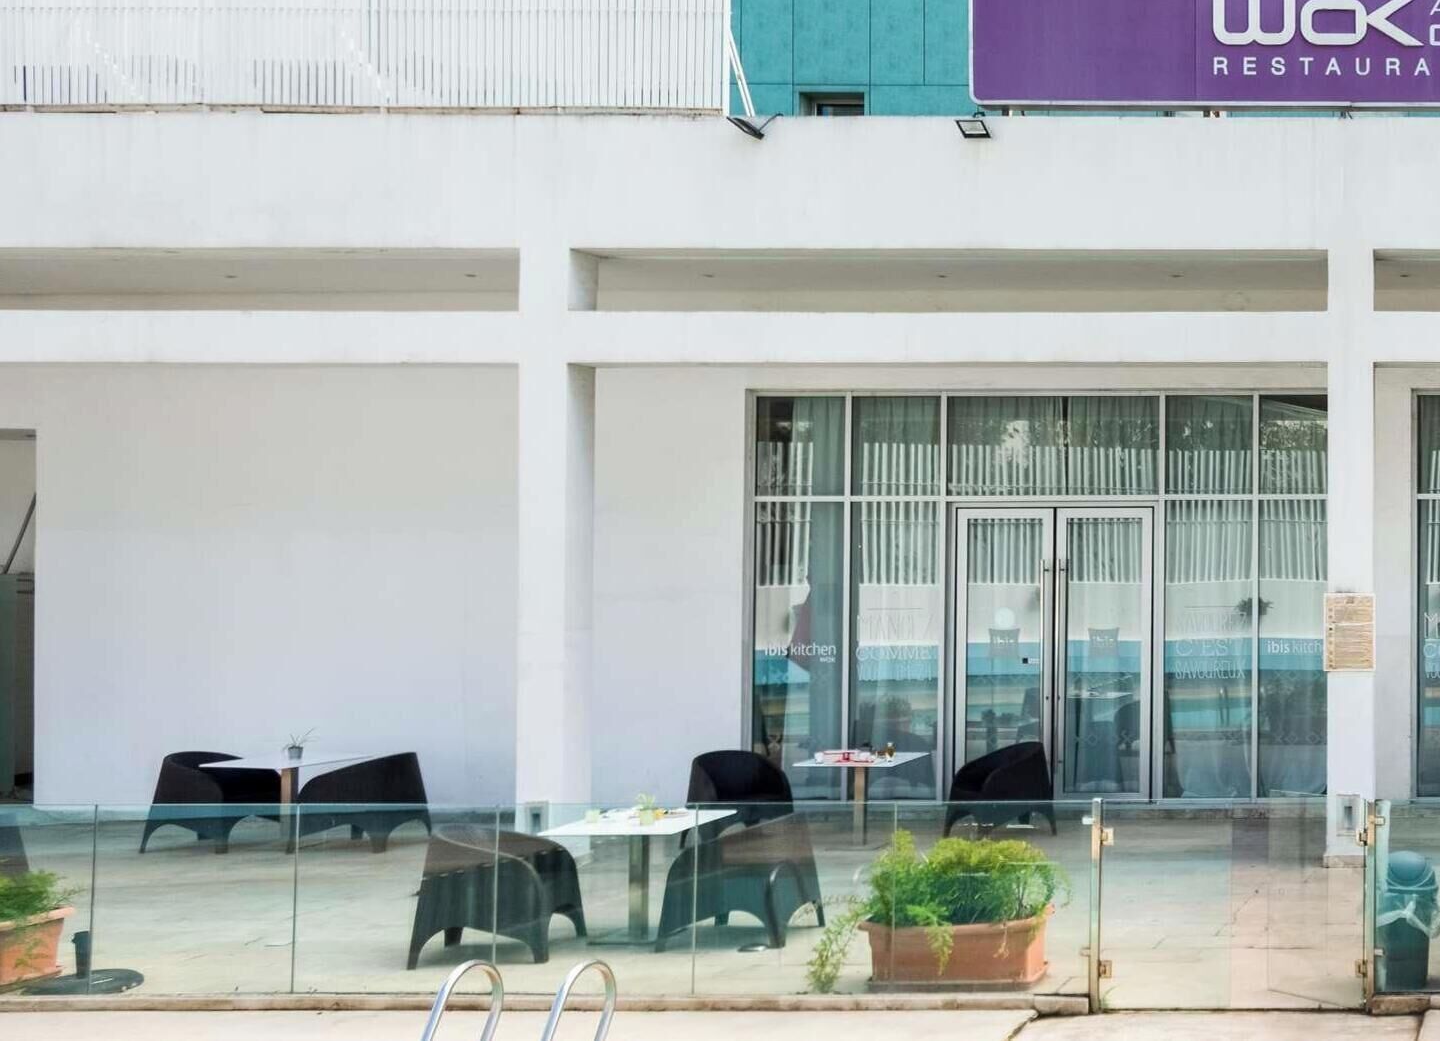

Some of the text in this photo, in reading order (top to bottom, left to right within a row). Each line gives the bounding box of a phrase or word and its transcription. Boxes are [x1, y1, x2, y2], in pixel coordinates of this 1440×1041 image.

[764, 642, 837, 656] ibis kitchen
[1267, 640, 1322, 654] ibis kitch
